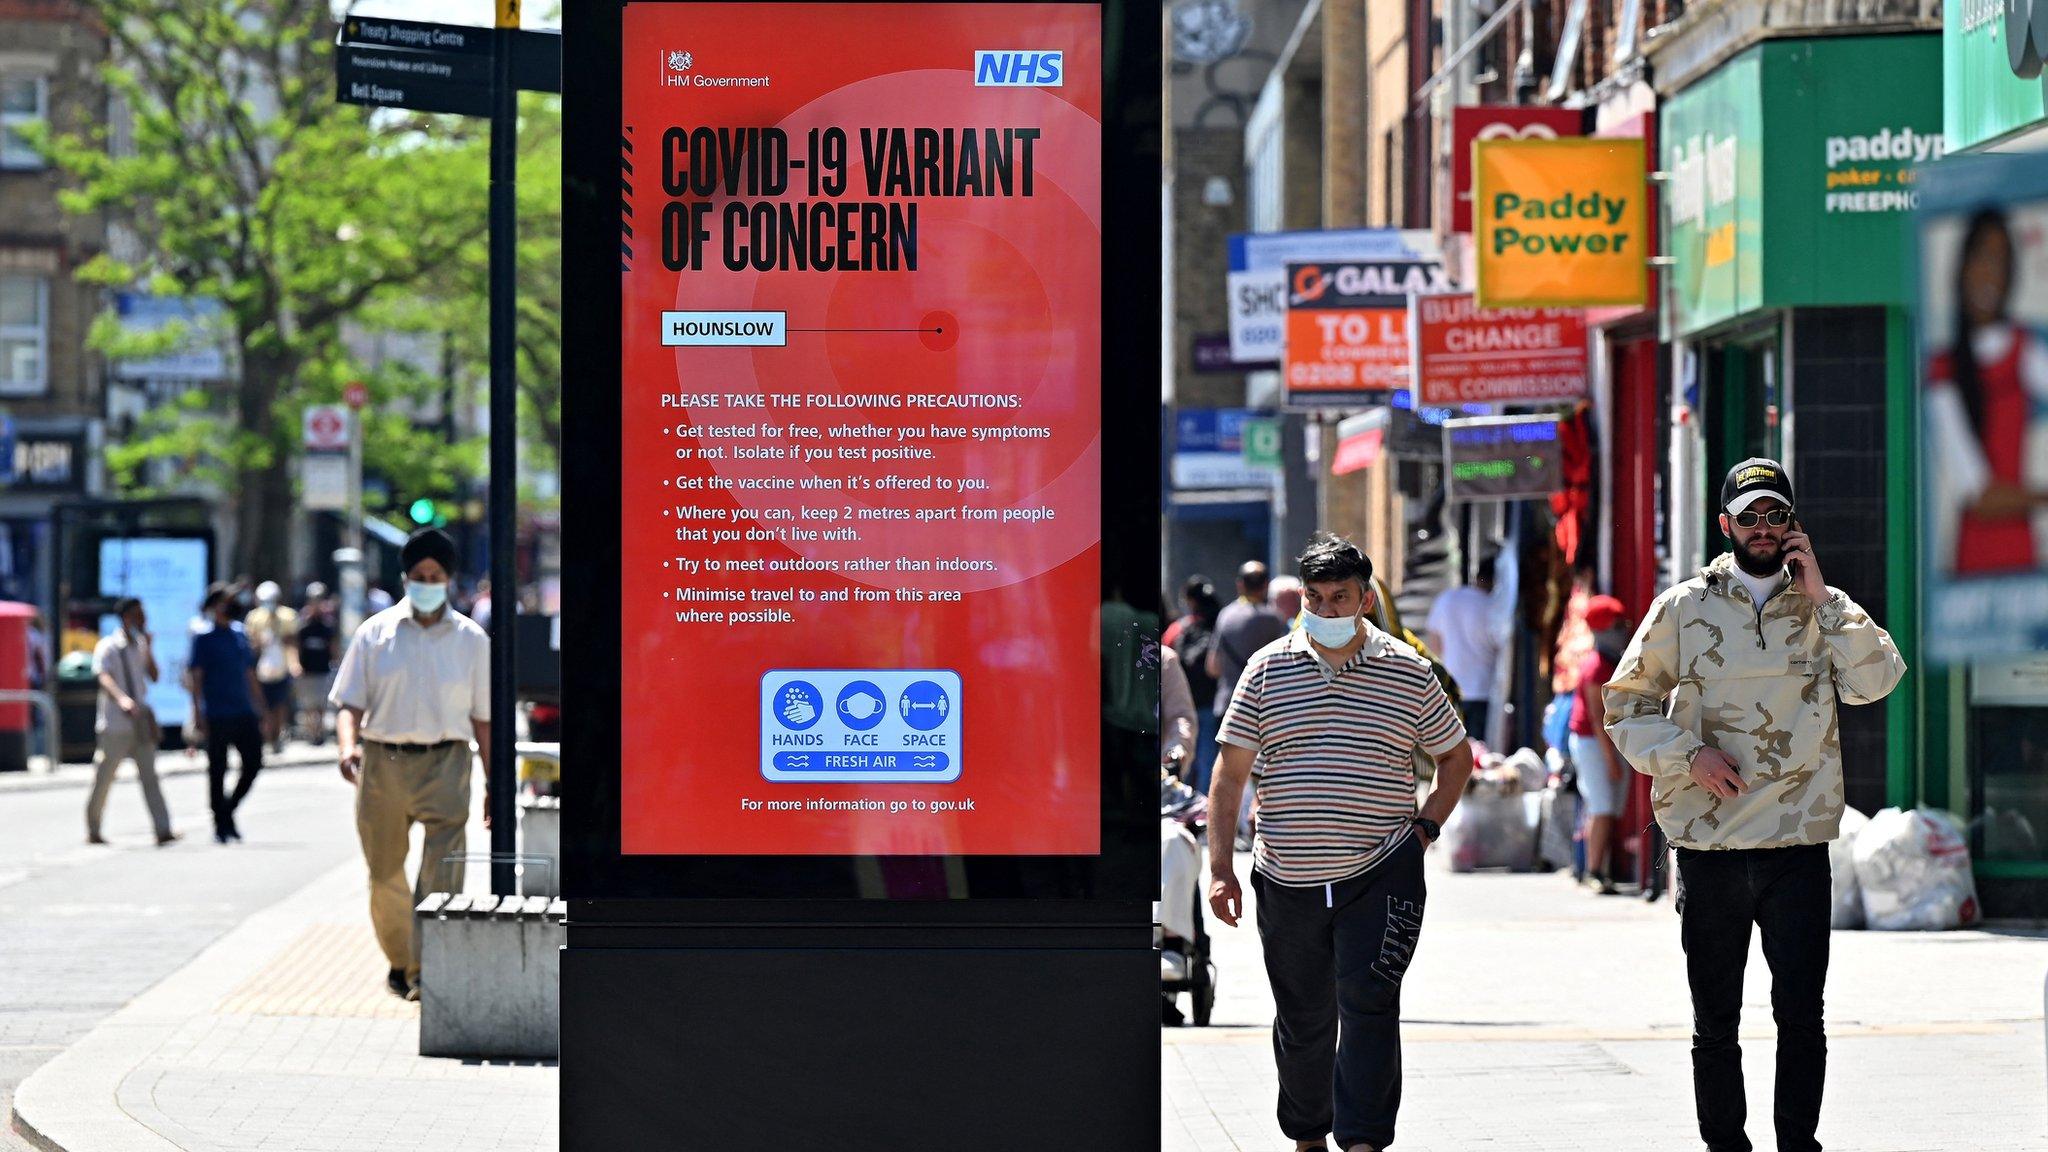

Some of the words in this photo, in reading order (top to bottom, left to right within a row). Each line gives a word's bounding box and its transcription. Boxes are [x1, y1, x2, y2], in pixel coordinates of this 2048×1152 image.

[360, 22, 387, 41] Treaty
[390, 25, 431, 46] Shopping
[432, 29, 465, 47] Centre
[977, 53, 1061, 84] NHS
[667, 74, 690, 87] HM
[693, 74, 770, 87] Government
[351, 82, 370, 98] Bell
[371, 84, 404, 102] Square
[661, 126, 847, 198] COVID-19
[859, 127, 1041, 197] VARIANT
[1826, 168, 1881, 189] poker
[1494, 191, 1627, 226] Paddy
[661, 201, 714, 272] OF
[722, 201, 918, 272] CONCERN
[1494, 227, 1628, 256] Power
[673, 322, 774, 336] HOUNSLOW
[1315, 314, 1370, 345] TO
[1445, 323, 1562, 352] CHANGE
[661, 393, 720, 408] PLEASE
[723, 393, 766, 408] TAKE
[770, 394, 801, 408] THE
[806, 394, 902, 408] FOLLOWING
[906, 394, 1022, 408] PRECAUTIONS:
[676, 424, 704, 438] Get
[707, 423, 756, 438] tested
[760, 422, 784, 438] for
[788, 423, 823, 440] free,
[827, 423, 893, 438] whether
[897, 427, 925, 442] you
[930, 423, 967, 438] have
[971, 424, 1051, 442] symptoms
[676, 448, 693, 459] or
[697, 446, 728, 459] not.
[733, 444, 785, 459] Isolate
[789, 444, 801, 459] if
[804, 448, 833, 463] you
[837, 446, 867, 459] test
[871, 445, 936, 463] positive.
[676, 475, 704, 489] Get
[707, 475, 734, 489] the
[737, 475, 795, 489] vaccine
[799, 474, 842, 490] when
[847, 475, 871, 490] it’s
[875, 474, 931, 490] offered
[935, 476, 953, 490] to
[957, 478, 990, 493] you.
[675, 505, 727, 520] Where
[730, 508, 759, 523] you
[763, 508, 795, 522] can,
[801, 505, 839, 523] keep
[843, 505, 853, 520] 2
[858, 506, 911, 520] metres
[914, 506, 957, 523] apart
[961, 505, 998, 520] from
[1002, 505, 1055, 524] people
[675, 526, 708, 541] that
[712, 530, 741, 545] you
[745, 526, 787, 541] don’t
[791, 526, 818, 541] live
[822, 526, 862, 541] with.
[675, 557, 700, 575] Try
[704, 558, 721, 571] to
[725, 558, 765, 571] meet
[769, 556, 840, 571] outdoors
[844, 556, 892, 571] rather
[894, 556, 931, 571] than
[935, 556, 998, 571] indoors.
[676, 587, 746, 601] Minimise
[750, 586, 794, 601] travel
[798, 588, 815, 602] to
[819, 586, 849, 602] and
[853, 586, 890, 602] from
[894, 586, 924, 602] this
[928, 589, 962, 602] area
[675, 608, 724, 623] where
[728, 608, 795, 626] possible.
[772, 733, 824, 746] HANDS
[844, 734, 879, 746] FACE
[902, 734, 946, 746] SPACE
[825, 755, 868, 768] FRESH
[872, 755, 897, 768] AIR
[741, 798, 764, 810] For
[767, 800, 802, 811] more
[806, 797, 886, 811] information
[889, 800, 908, 814] go
[911, 798, 926, 811] to
[929, 797, 976, 814] gov.uk
